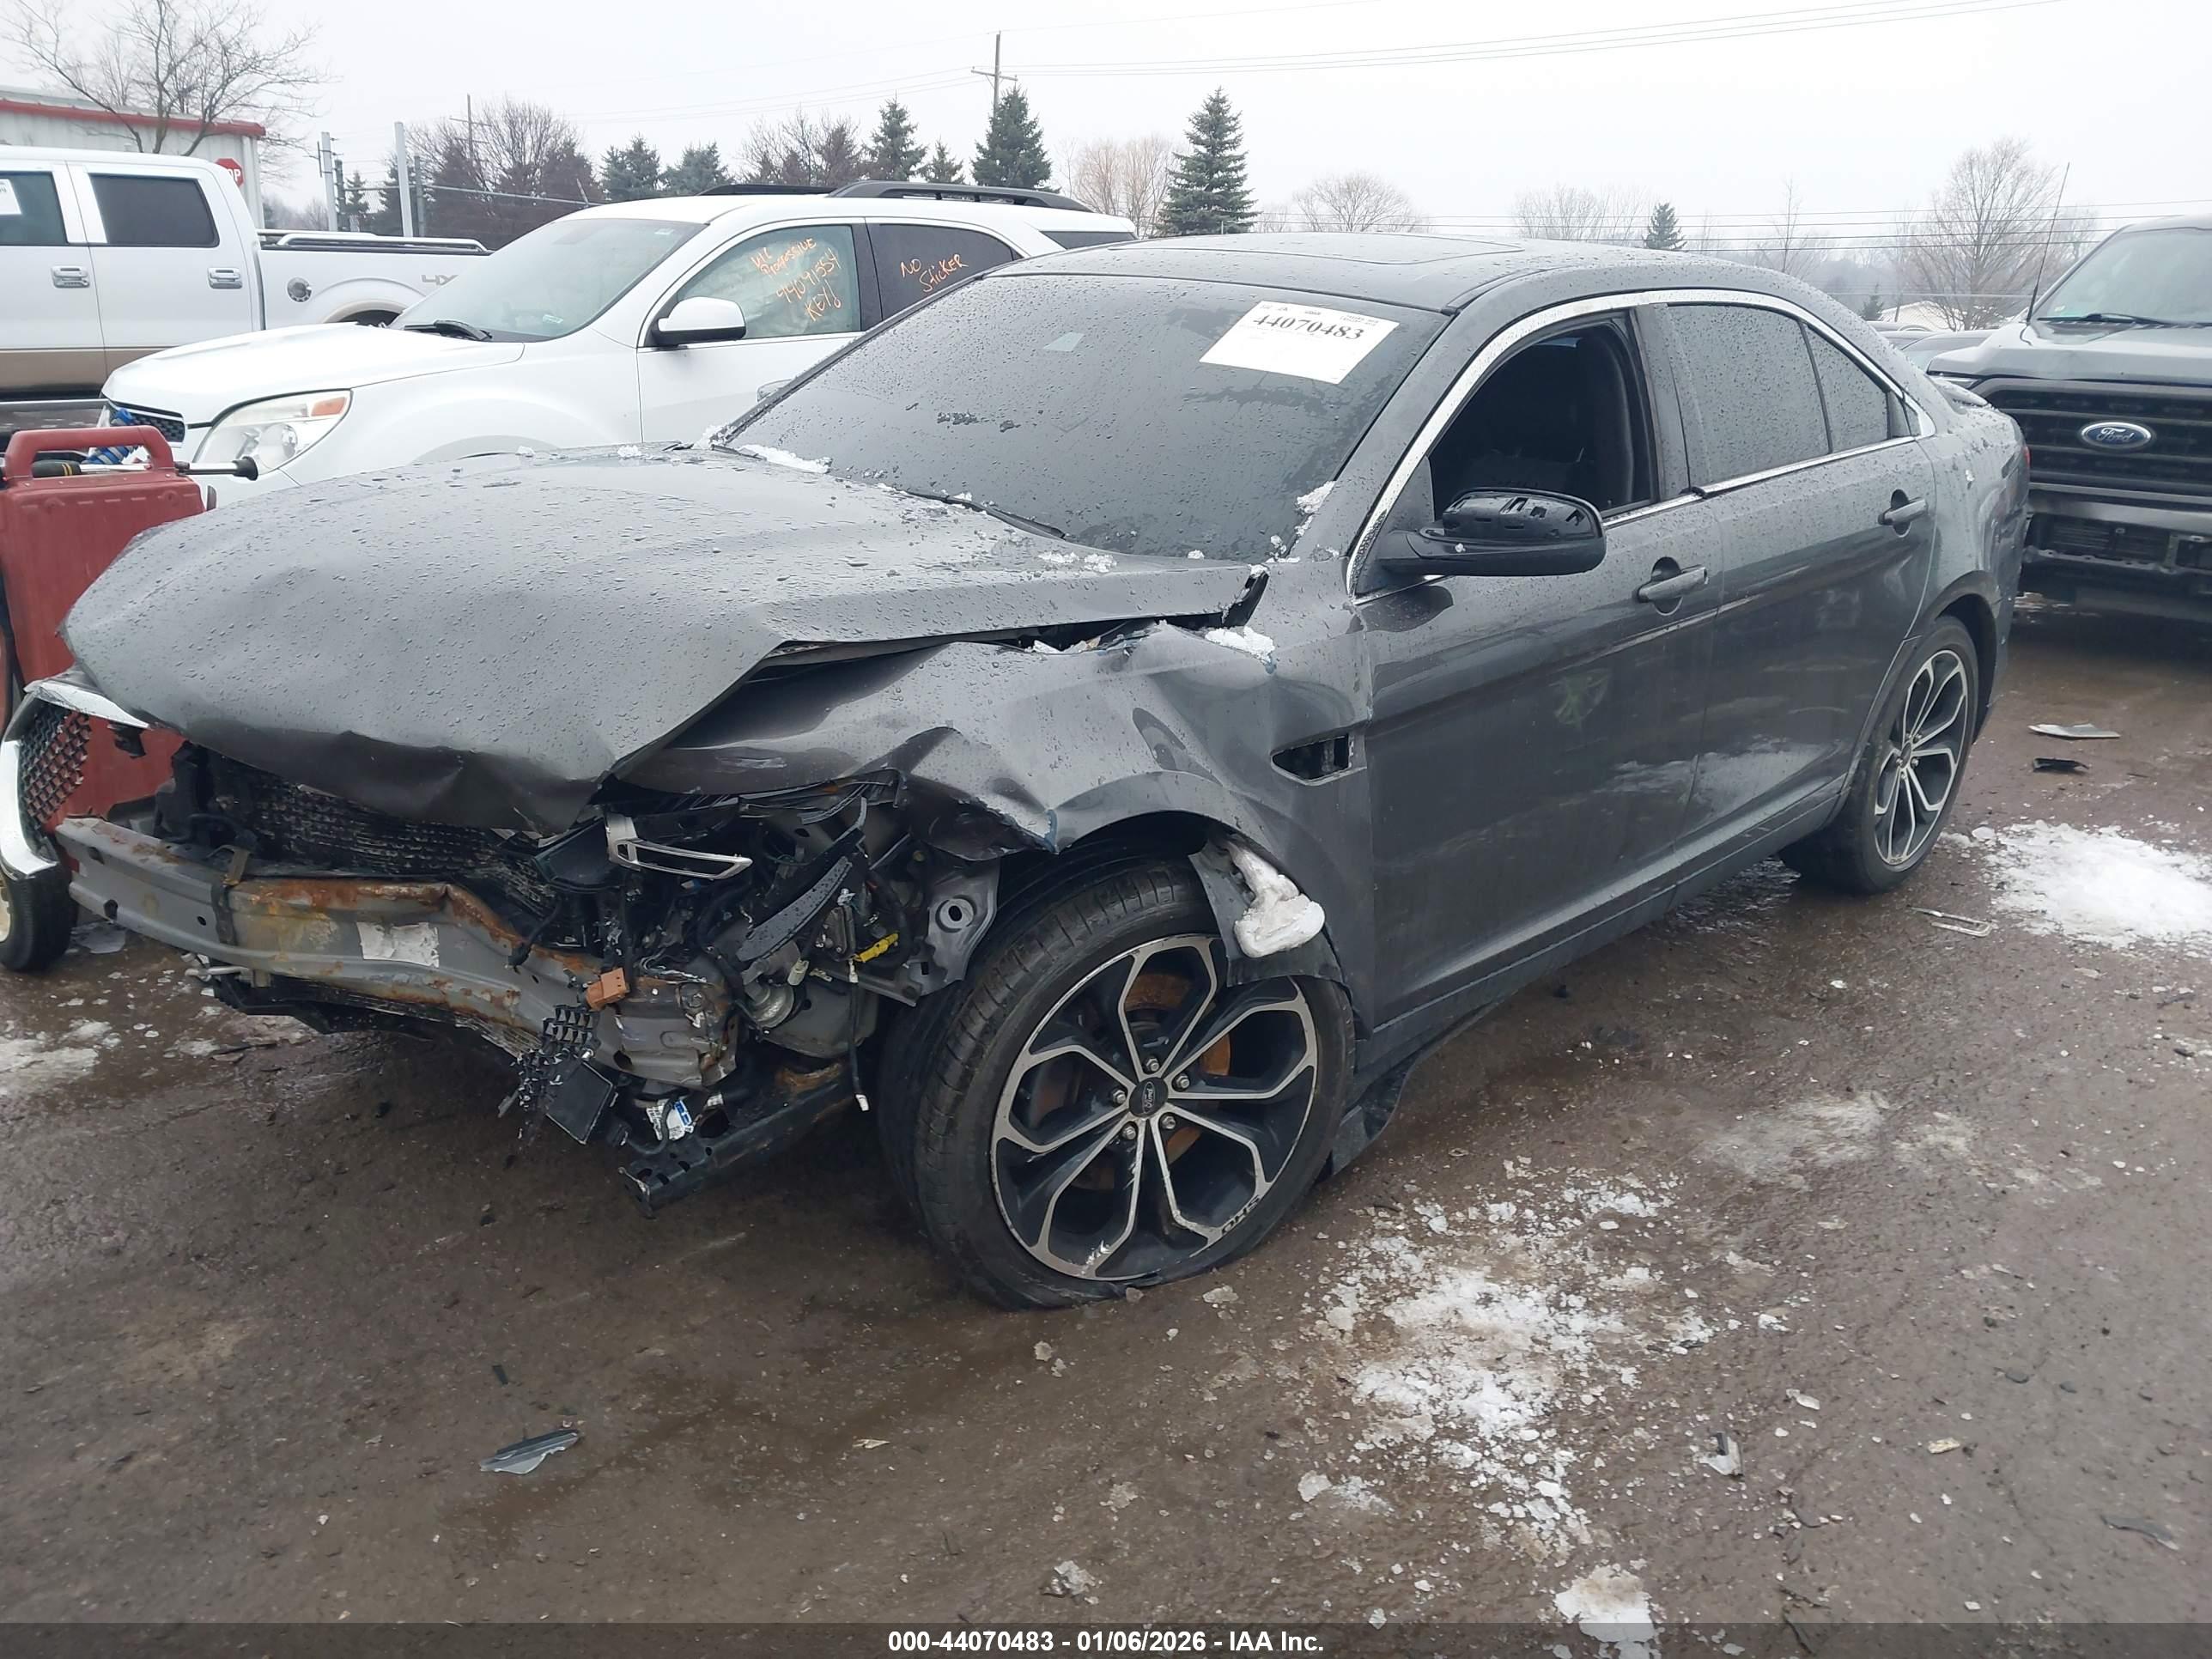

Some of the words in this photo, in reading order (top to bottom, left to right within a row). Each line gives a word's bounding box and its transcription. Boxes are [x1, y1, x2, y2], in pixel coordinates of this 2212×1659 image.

[900, 258, 921, 278] NO
[1253, 314, 1364, 340] 44070483
[2096, 427, 2136, 441] Ford
